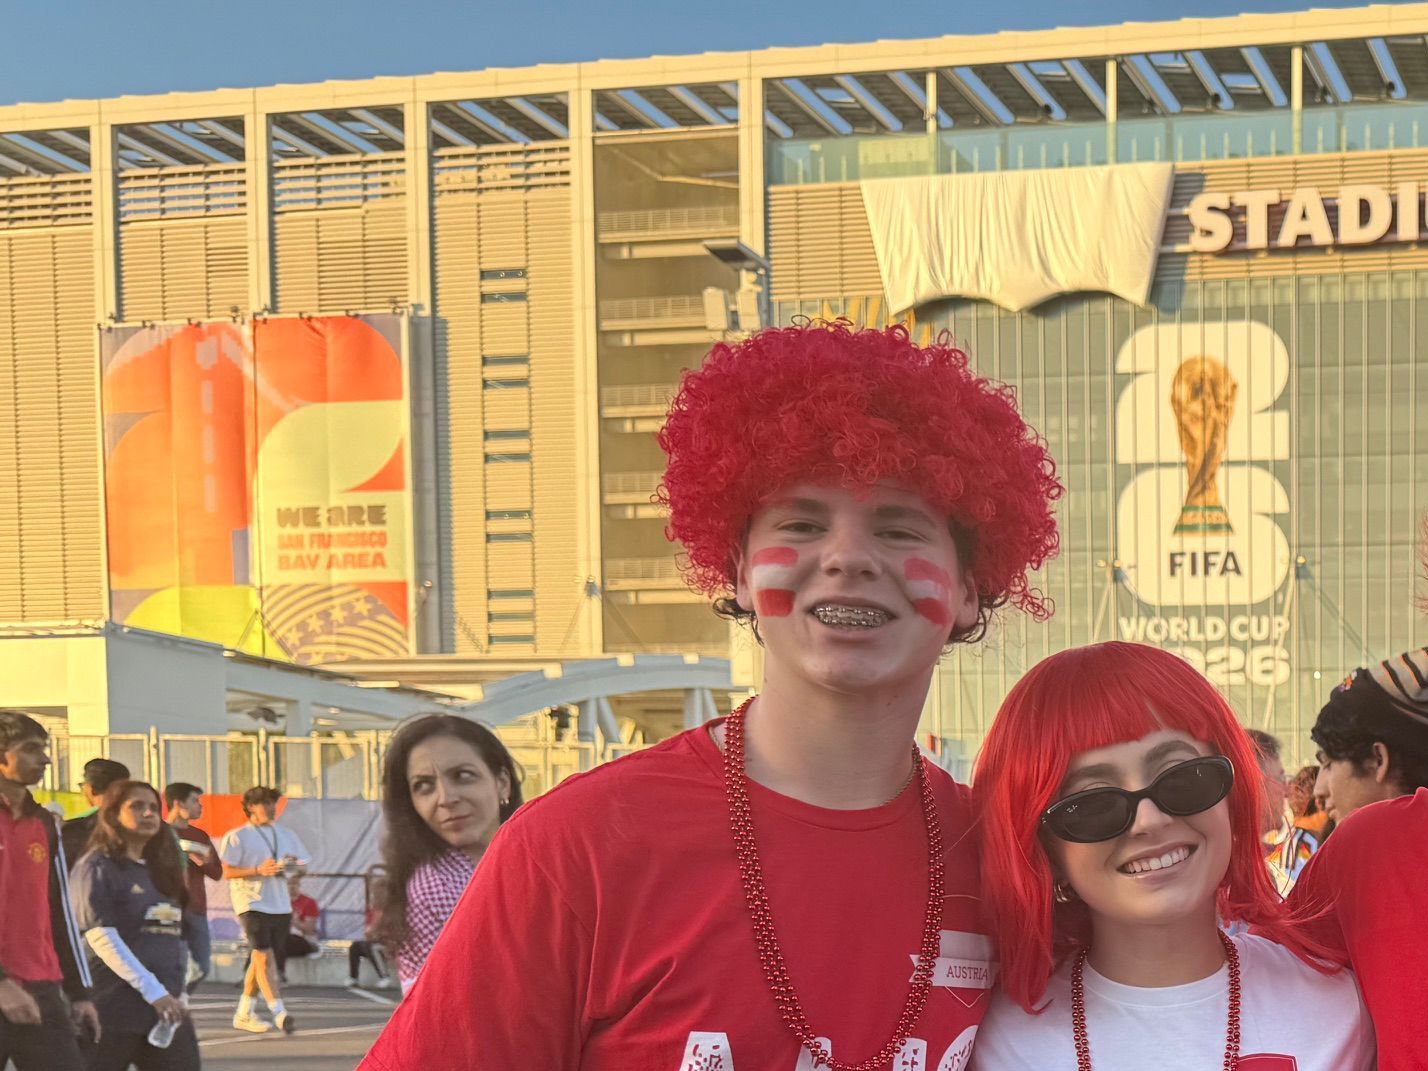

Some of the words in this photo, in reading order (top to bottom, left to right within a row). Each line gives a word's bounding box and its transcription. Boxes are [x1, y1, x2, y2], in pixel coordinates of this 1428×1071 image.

[277, 507, 321, 528] WE
[278, 553, 320, 571] BAY
[326, 552, 387, 571] AREA
[1169, 551, 1242, 577] FIFA
[1118, 616, 1227, 642] WORLD
[1229, 615, 1290, 642] CUP
[1168, 645, 1290, 686] 26
[946, 965, 988, 980] AUSTRIA
